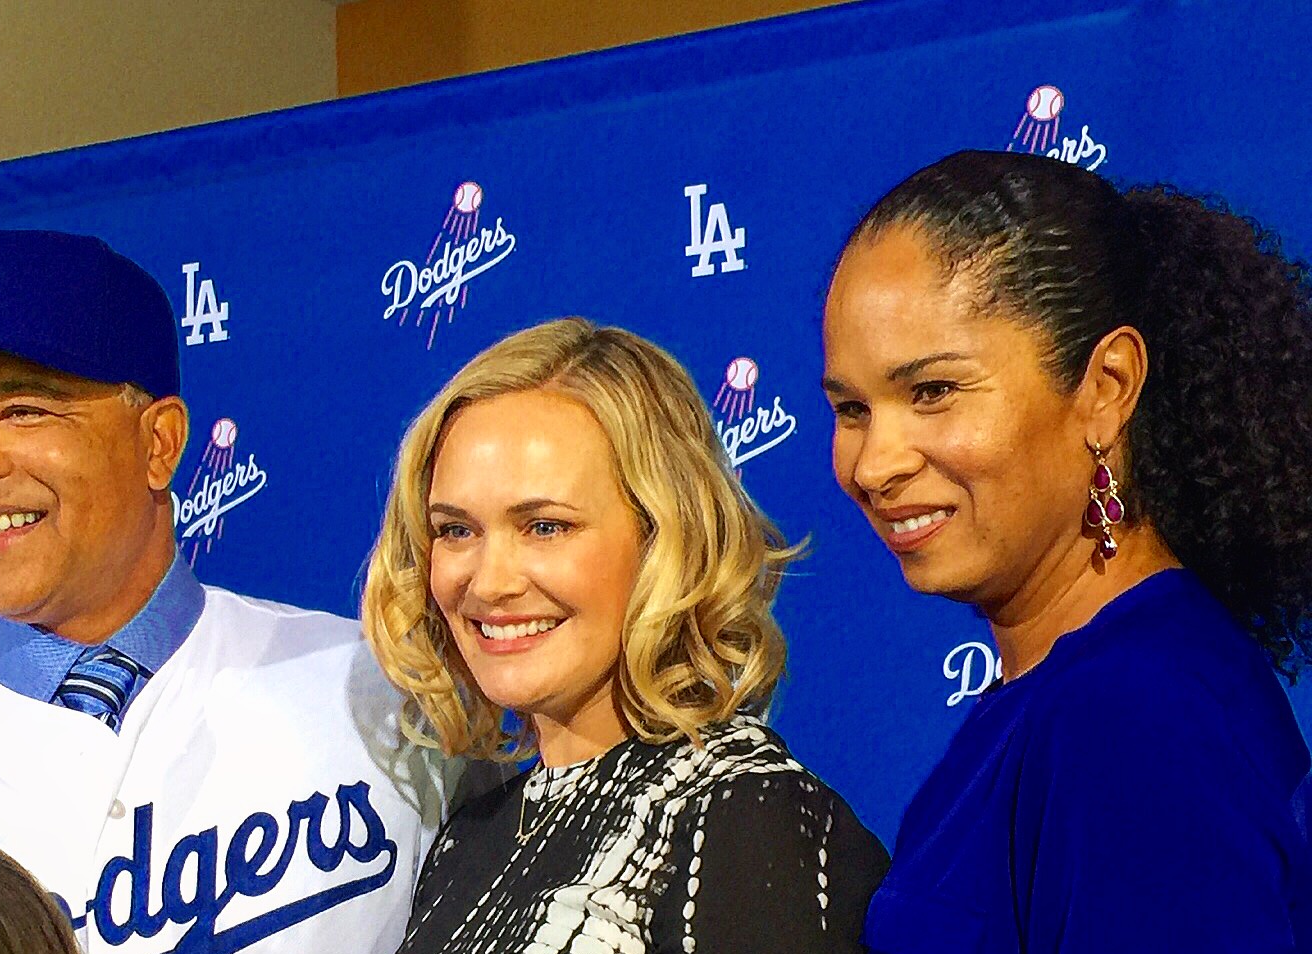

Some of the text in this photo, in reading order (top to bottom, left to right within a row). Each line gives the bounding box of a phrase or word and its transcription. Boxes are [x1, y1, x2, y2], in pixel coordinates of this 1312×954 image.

[381, 216, 517, 320] Dodgers
[684, 184, 746, 277] LA
[181, 261, 229, 346] LA
[716, 396, 797, 468] gers
